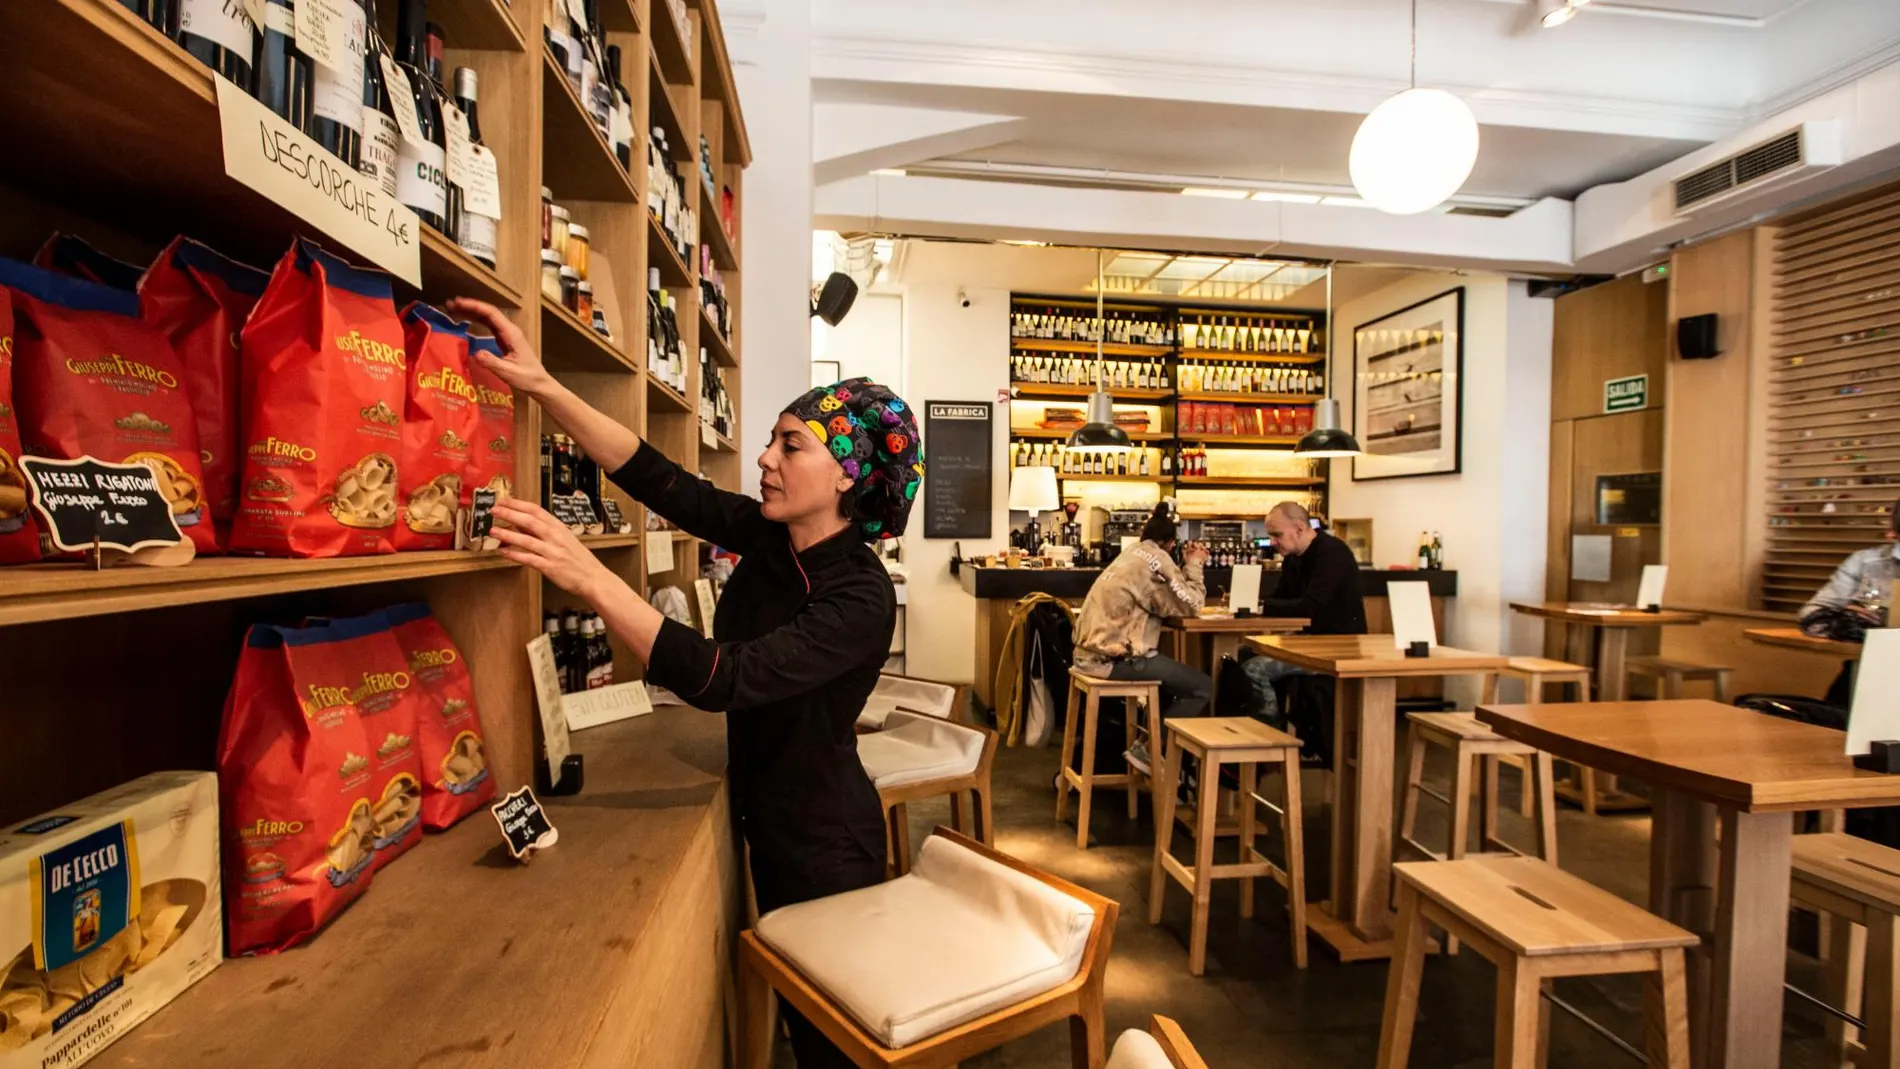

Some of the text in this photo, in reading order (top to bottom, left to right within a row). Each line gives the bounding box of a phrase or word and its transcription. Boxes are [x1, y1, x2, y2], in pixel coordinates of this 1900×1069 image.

[260, 120, 379, 226] DESCORCHE
[386, 208, 409, 246] 4€
[112, 353, 178, 388] FERRO
[1609, 380, 1645, 399] SALIDA
[934, 407, 946, 416] LA
[266, 437, 316, 462] FERRO
[363, 671, 411, 694] FERRO
[256, 818, 304, 835] FERRO
[52, 864, 72, 894] DE
[73, 843, 119, 883] CECCO
[41, 1013, 112, 1069] Pappardelle
